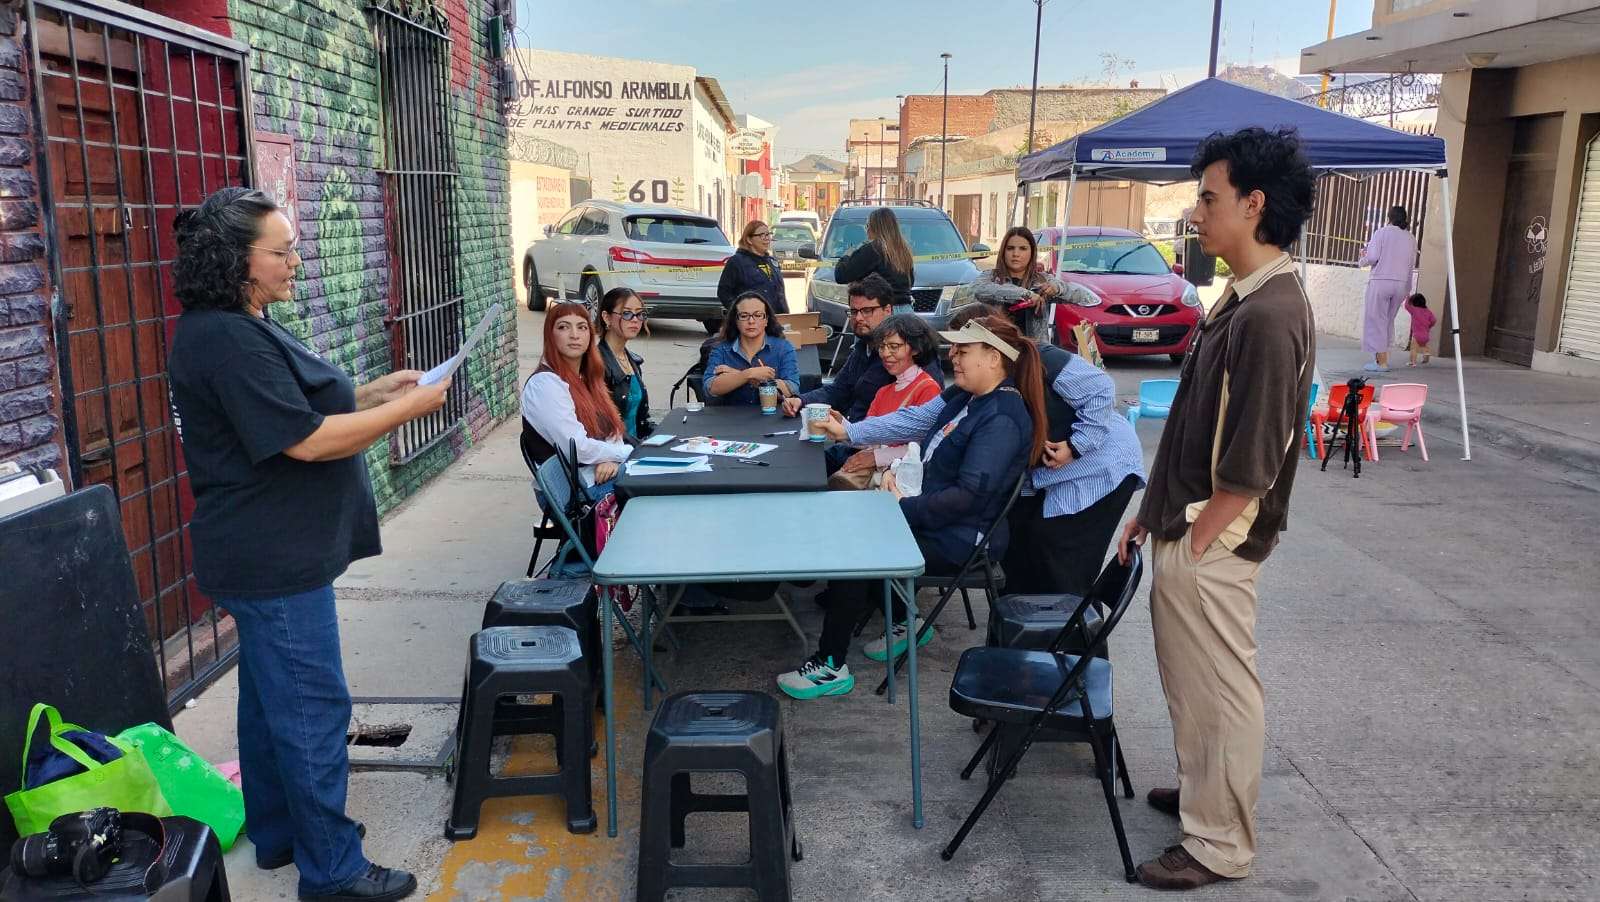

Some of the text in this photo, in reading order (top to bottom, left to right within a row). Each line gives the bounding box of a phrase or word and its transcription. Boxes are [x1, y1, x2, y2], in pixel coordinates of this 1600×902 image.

[545, 80, 613, 99] ALFONSO
[621, 82, 692, 101] ARAMBULA
[531, 105, 559, 115] MAS
[566, 107, 616, 117] GRANDE
[625, 108, 683, 119] SURTIDO
[532, 120, 591, 131] PLANTAS
[599, 121, 684, 132] MEDICINALES
[629, 180, 669, 203] 60
